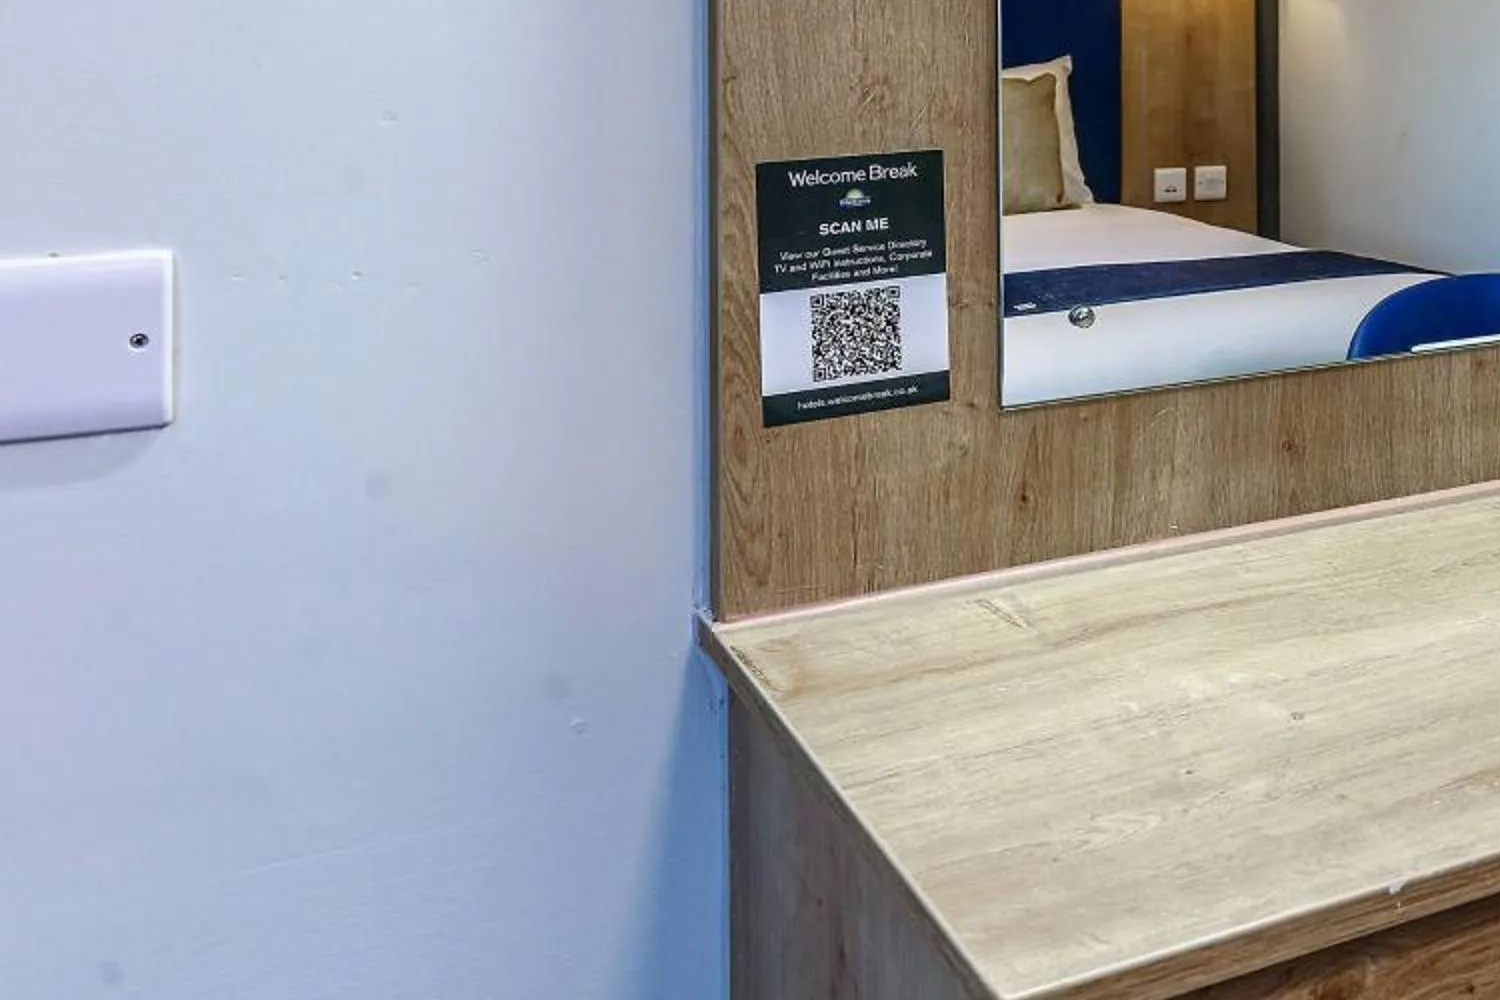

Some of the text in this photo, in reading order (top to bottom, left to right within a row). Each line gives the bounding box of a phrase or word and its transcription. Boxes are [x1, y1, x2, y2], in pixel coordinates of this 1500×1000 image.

[788, 162, 918, 187] Welcome Break
[819, 217, 889, 236] SCAN ME
[774, 263, 787, 274] TV
[789, 261, 807, 273] and
